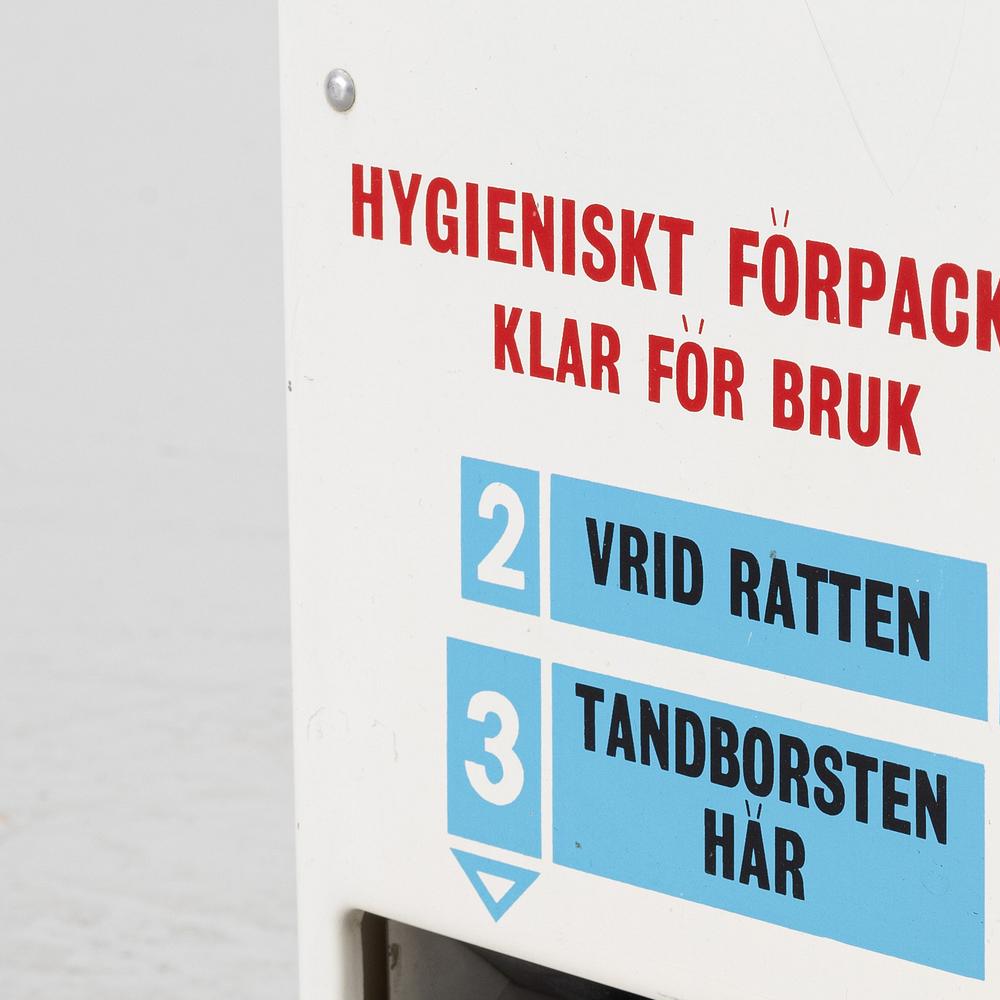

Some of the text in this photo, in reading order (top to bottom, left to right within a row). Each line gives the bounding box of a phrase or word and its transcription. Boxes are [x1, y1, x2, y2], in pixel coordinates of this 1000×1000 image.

[352, 163, 694, 295] HYGIENISKT
[494, 304, 921, 455] KLAR FÖR BRUK
[477, 482, 930, 661] 2 VRID RATTEN
[465, 683, 947, 844] 3 TANDBORSTEN
[705, 800, 805, 900] HÄR
